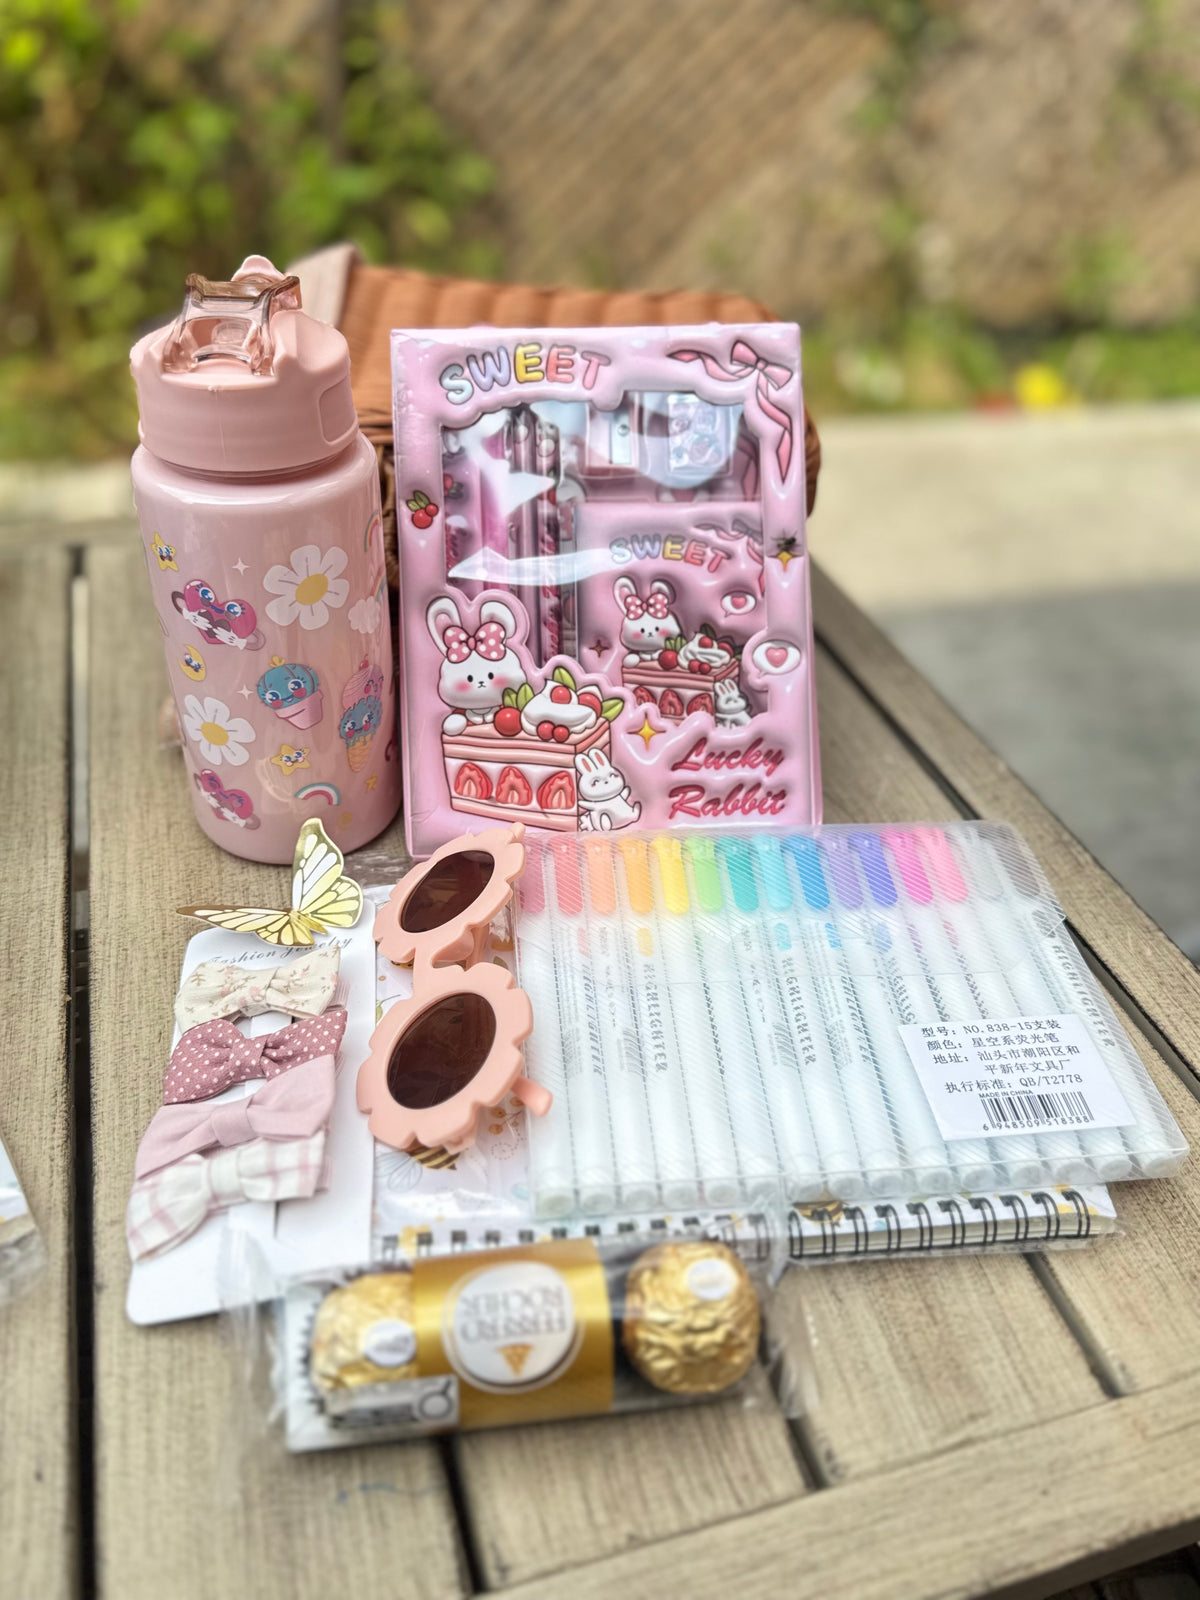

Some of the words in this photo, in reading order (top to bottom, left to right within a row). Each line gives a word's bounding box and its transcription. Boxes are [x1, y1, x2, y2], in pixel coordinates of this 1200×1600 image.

[439, 342, 611, 405] SWEET
[609, 533, 732, 573] SWEET
[671, 737, 785, 776] Lucky
[669, 782, 787, 819] Rabbit
[643, 963, 668, 1073] HIGHLIGHTER
[782, 956, 816, 1066] HIGHLIGHTER
[984, 1058, 1071, 1075] 平新年文具厂
[1010, 1089, 1034, 1097] CHINA
